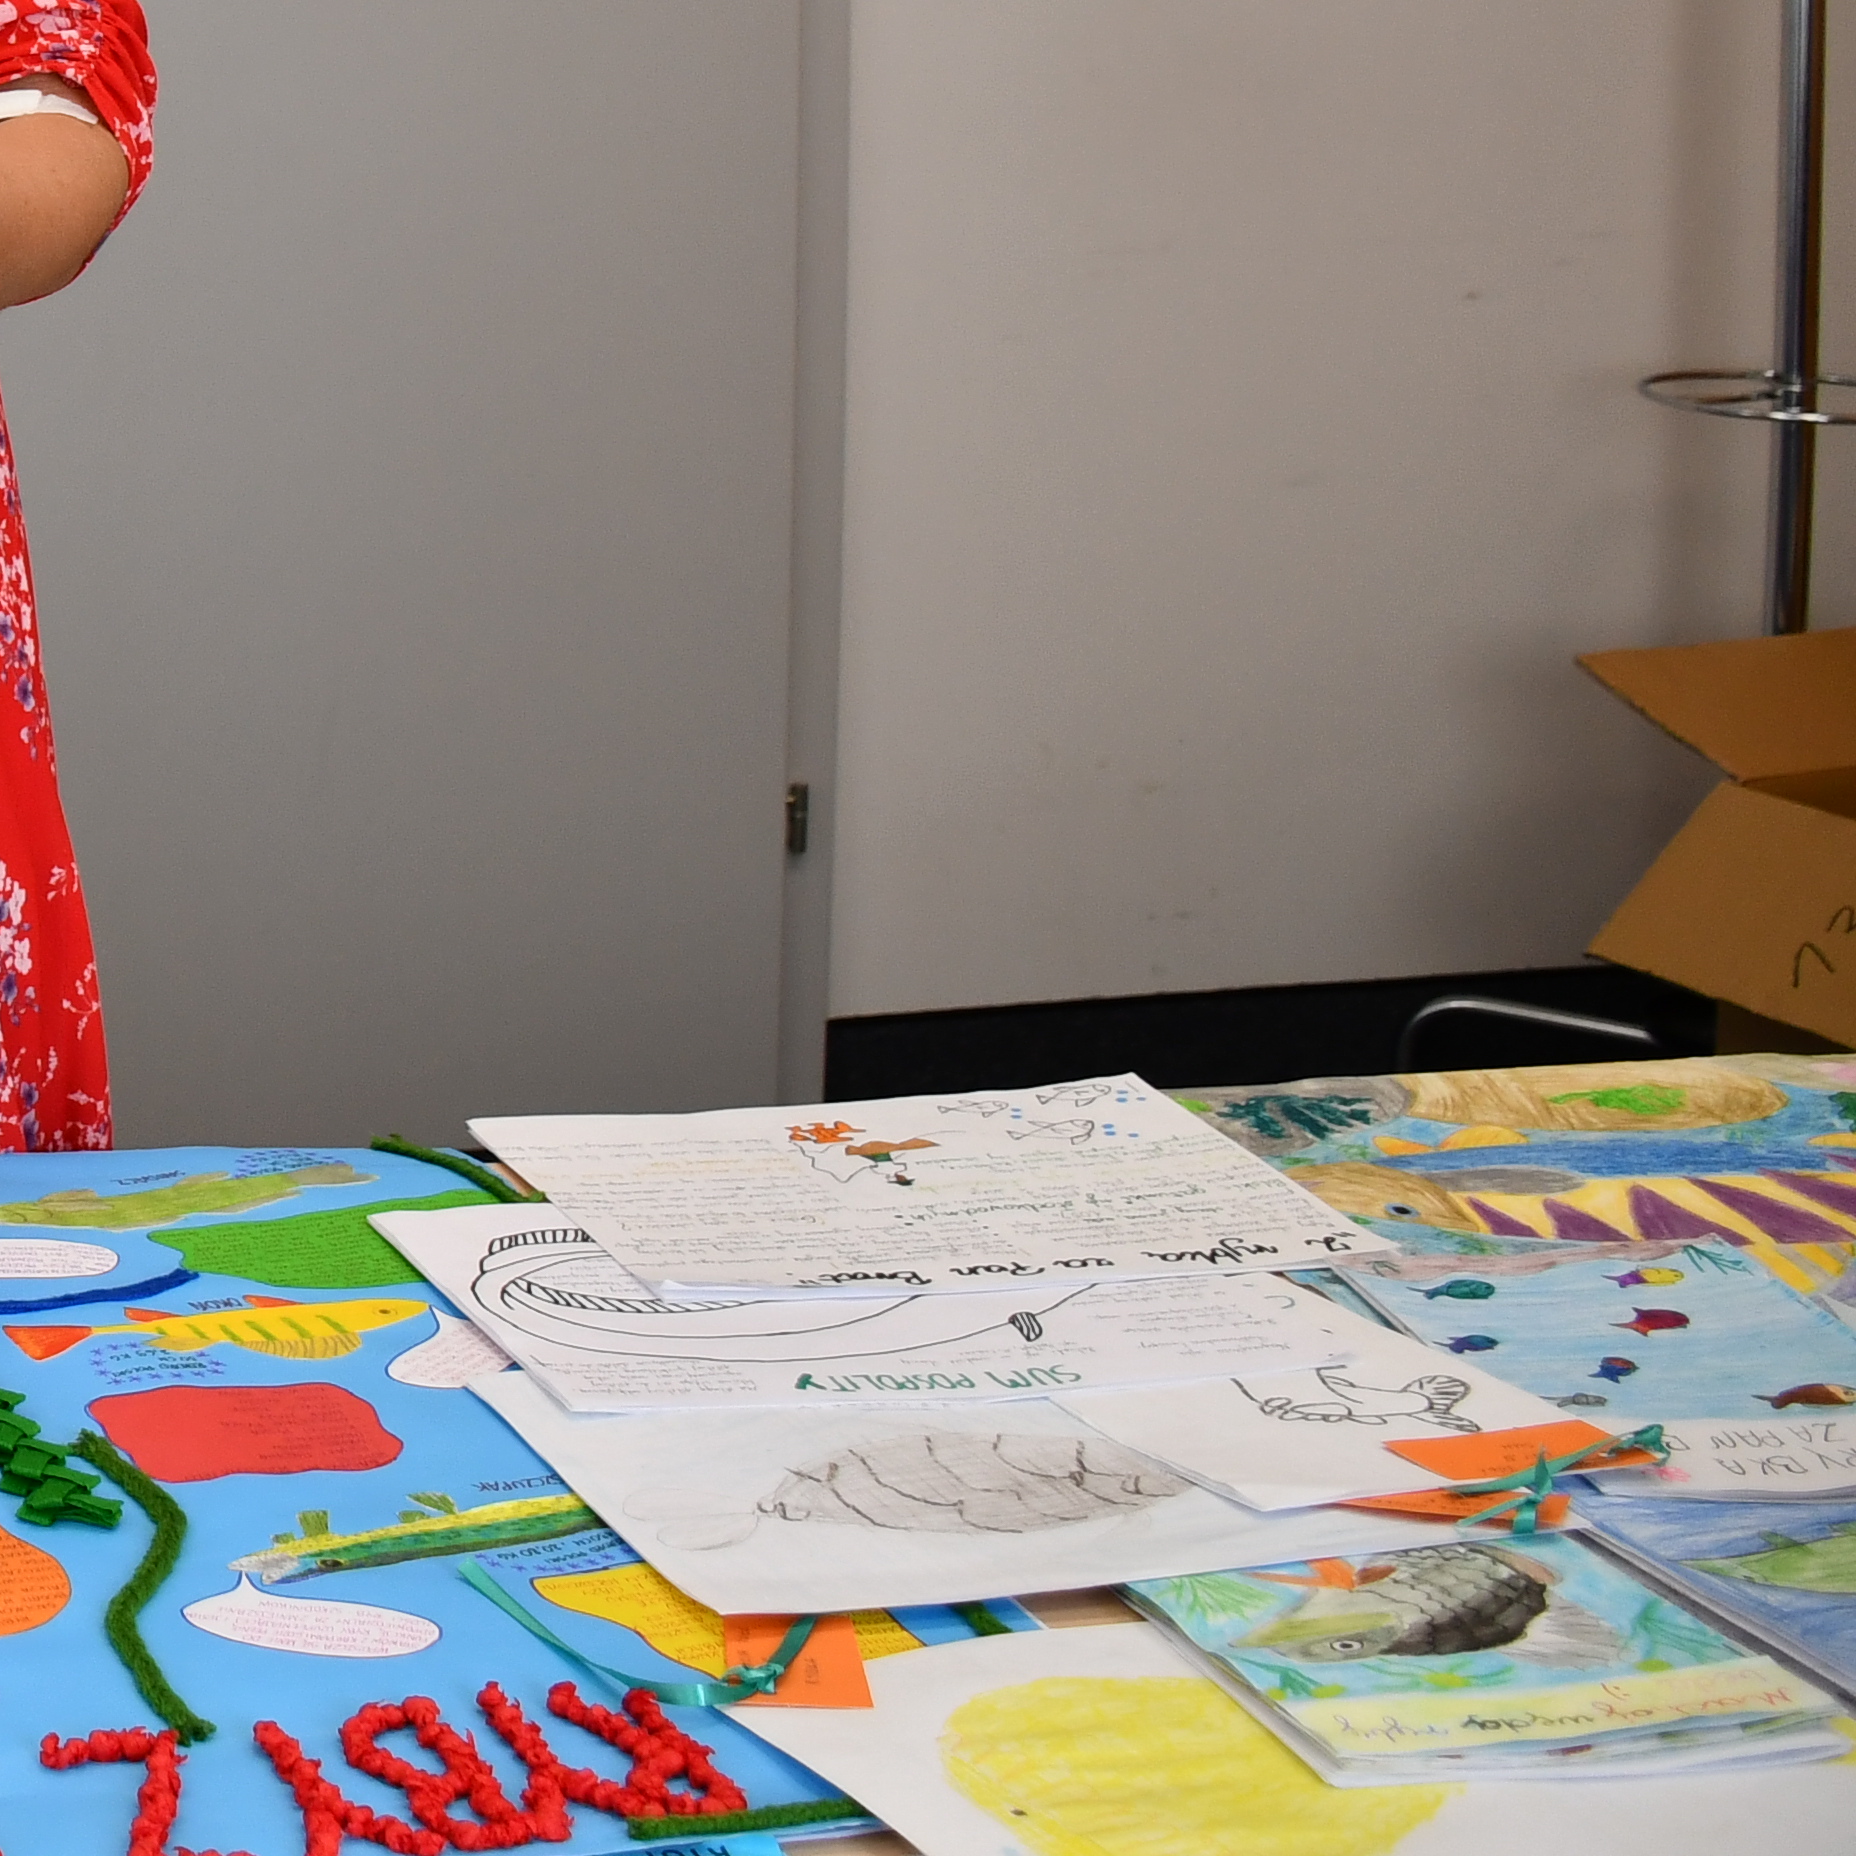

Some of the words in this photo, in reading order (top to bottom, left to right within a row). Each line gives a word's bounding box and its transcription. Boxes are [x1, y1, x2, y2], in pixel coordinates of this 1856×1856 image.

[950, 1262, 1045, 1276] Pan
[794, 1373, 976, 1392] POSPOLITY
[984, 1364, 1081, 1388] SUM
[1710, 1430, 1784, 1449] PAN
[253, 1682, 748, 1856] RYBY
